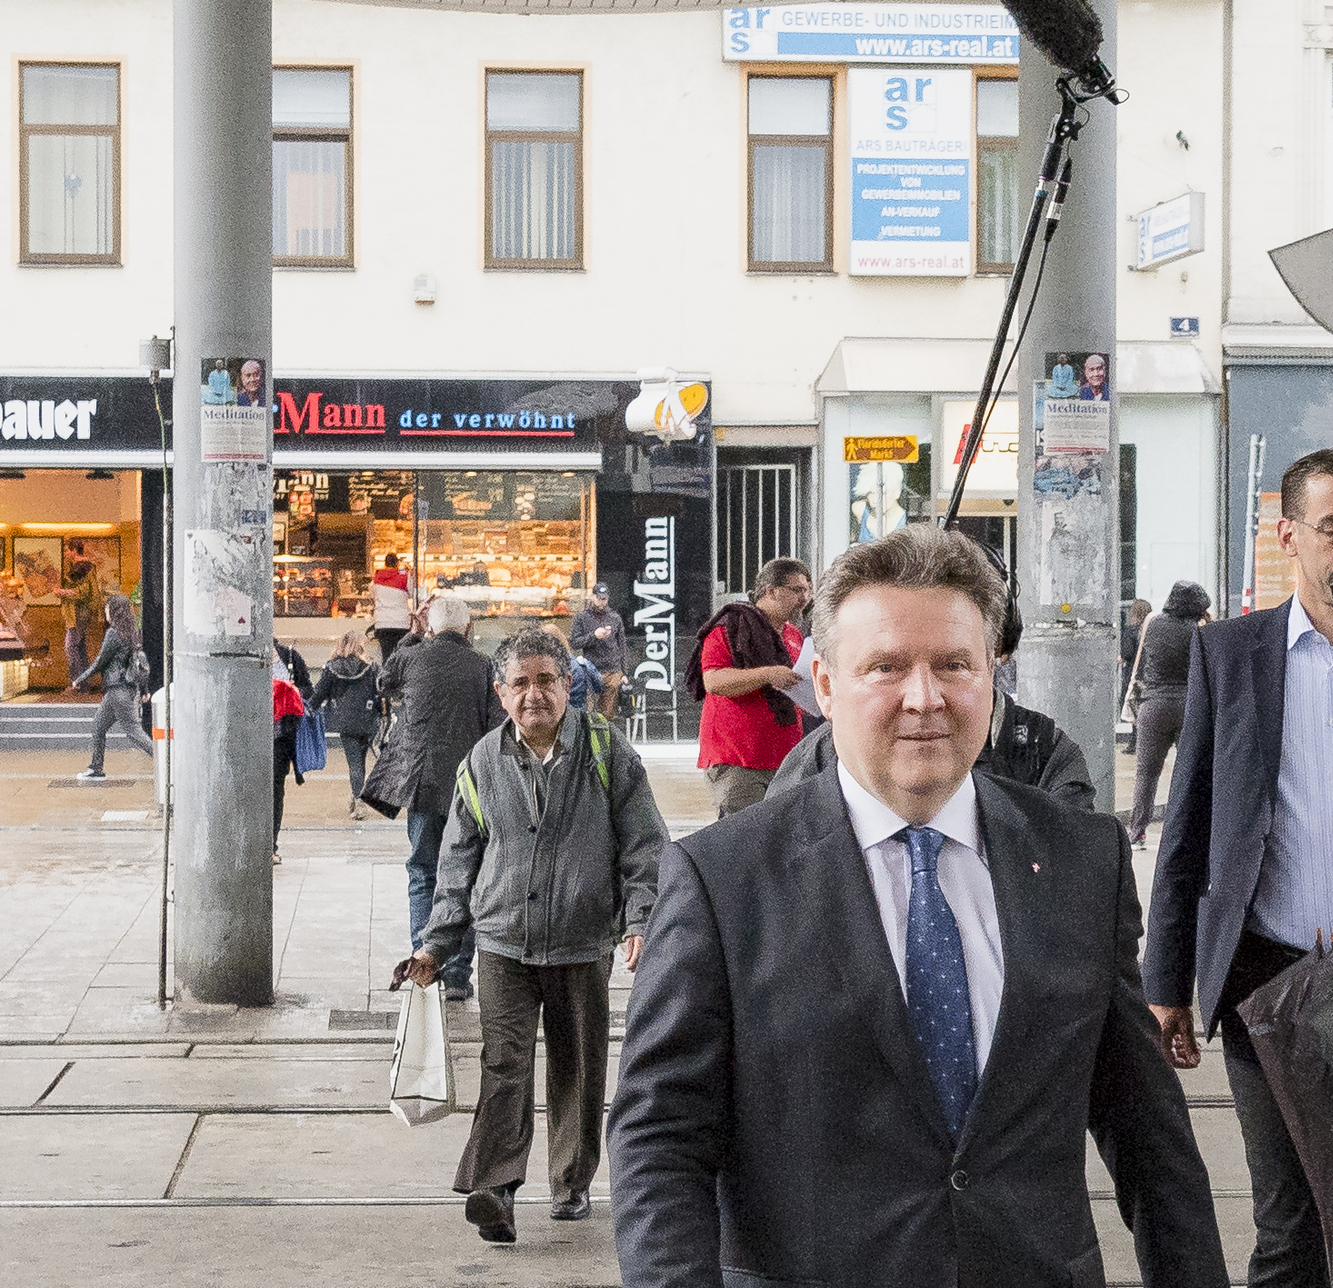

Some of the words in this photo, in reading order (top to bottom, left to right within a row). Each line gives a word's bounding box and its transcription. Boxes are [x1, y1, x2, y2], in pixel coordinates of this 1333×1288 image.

[782, 12, 869, 27] GEWERBE-
[875, 13, 909, 28] UND
[855, 36, 1013, 57] www.ars-real.at
[885, 77, 931, 102] ar
[857, 140, 881, 152] ARS
[857, 255, 964, 269] www.ars-real.at
[1179, 317, 1190, 332] 4
[272, 391, 386, 434] Mann
[399, 409, 442, 429] der
[454, 409, 576, 430] verwöhnt
[1047, 403, 1108, 415] Meditation
[0, 398, 98, 441] auer
[633, 515, 676, 692] DerMann
